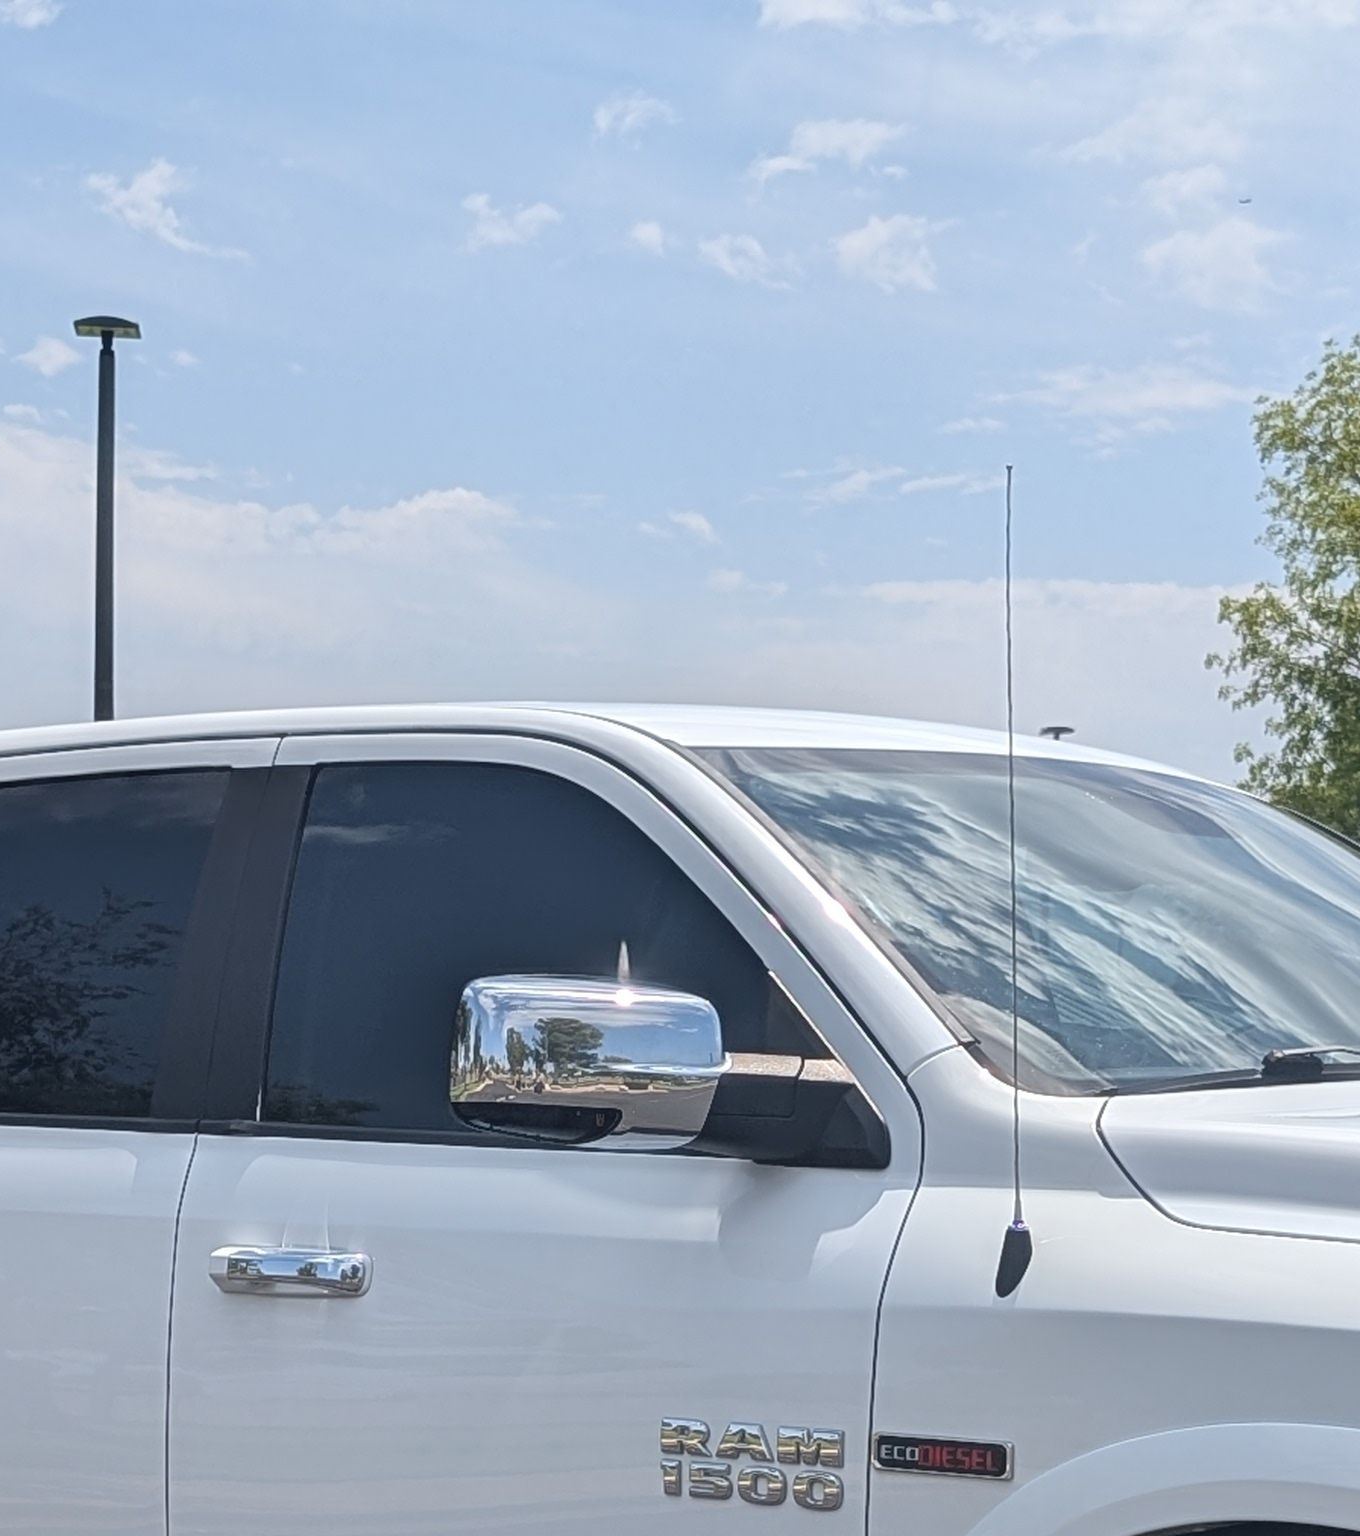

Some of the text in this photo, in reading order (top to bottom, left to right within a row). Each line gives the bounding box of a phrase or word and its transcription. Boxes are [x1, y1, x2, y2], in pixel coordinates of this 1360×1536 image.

[660, 1417, 846, 1468] RAM
[879, 1444, 995, 1471] ECODIESEL
[659, 1460, 846, 1511] 1500
